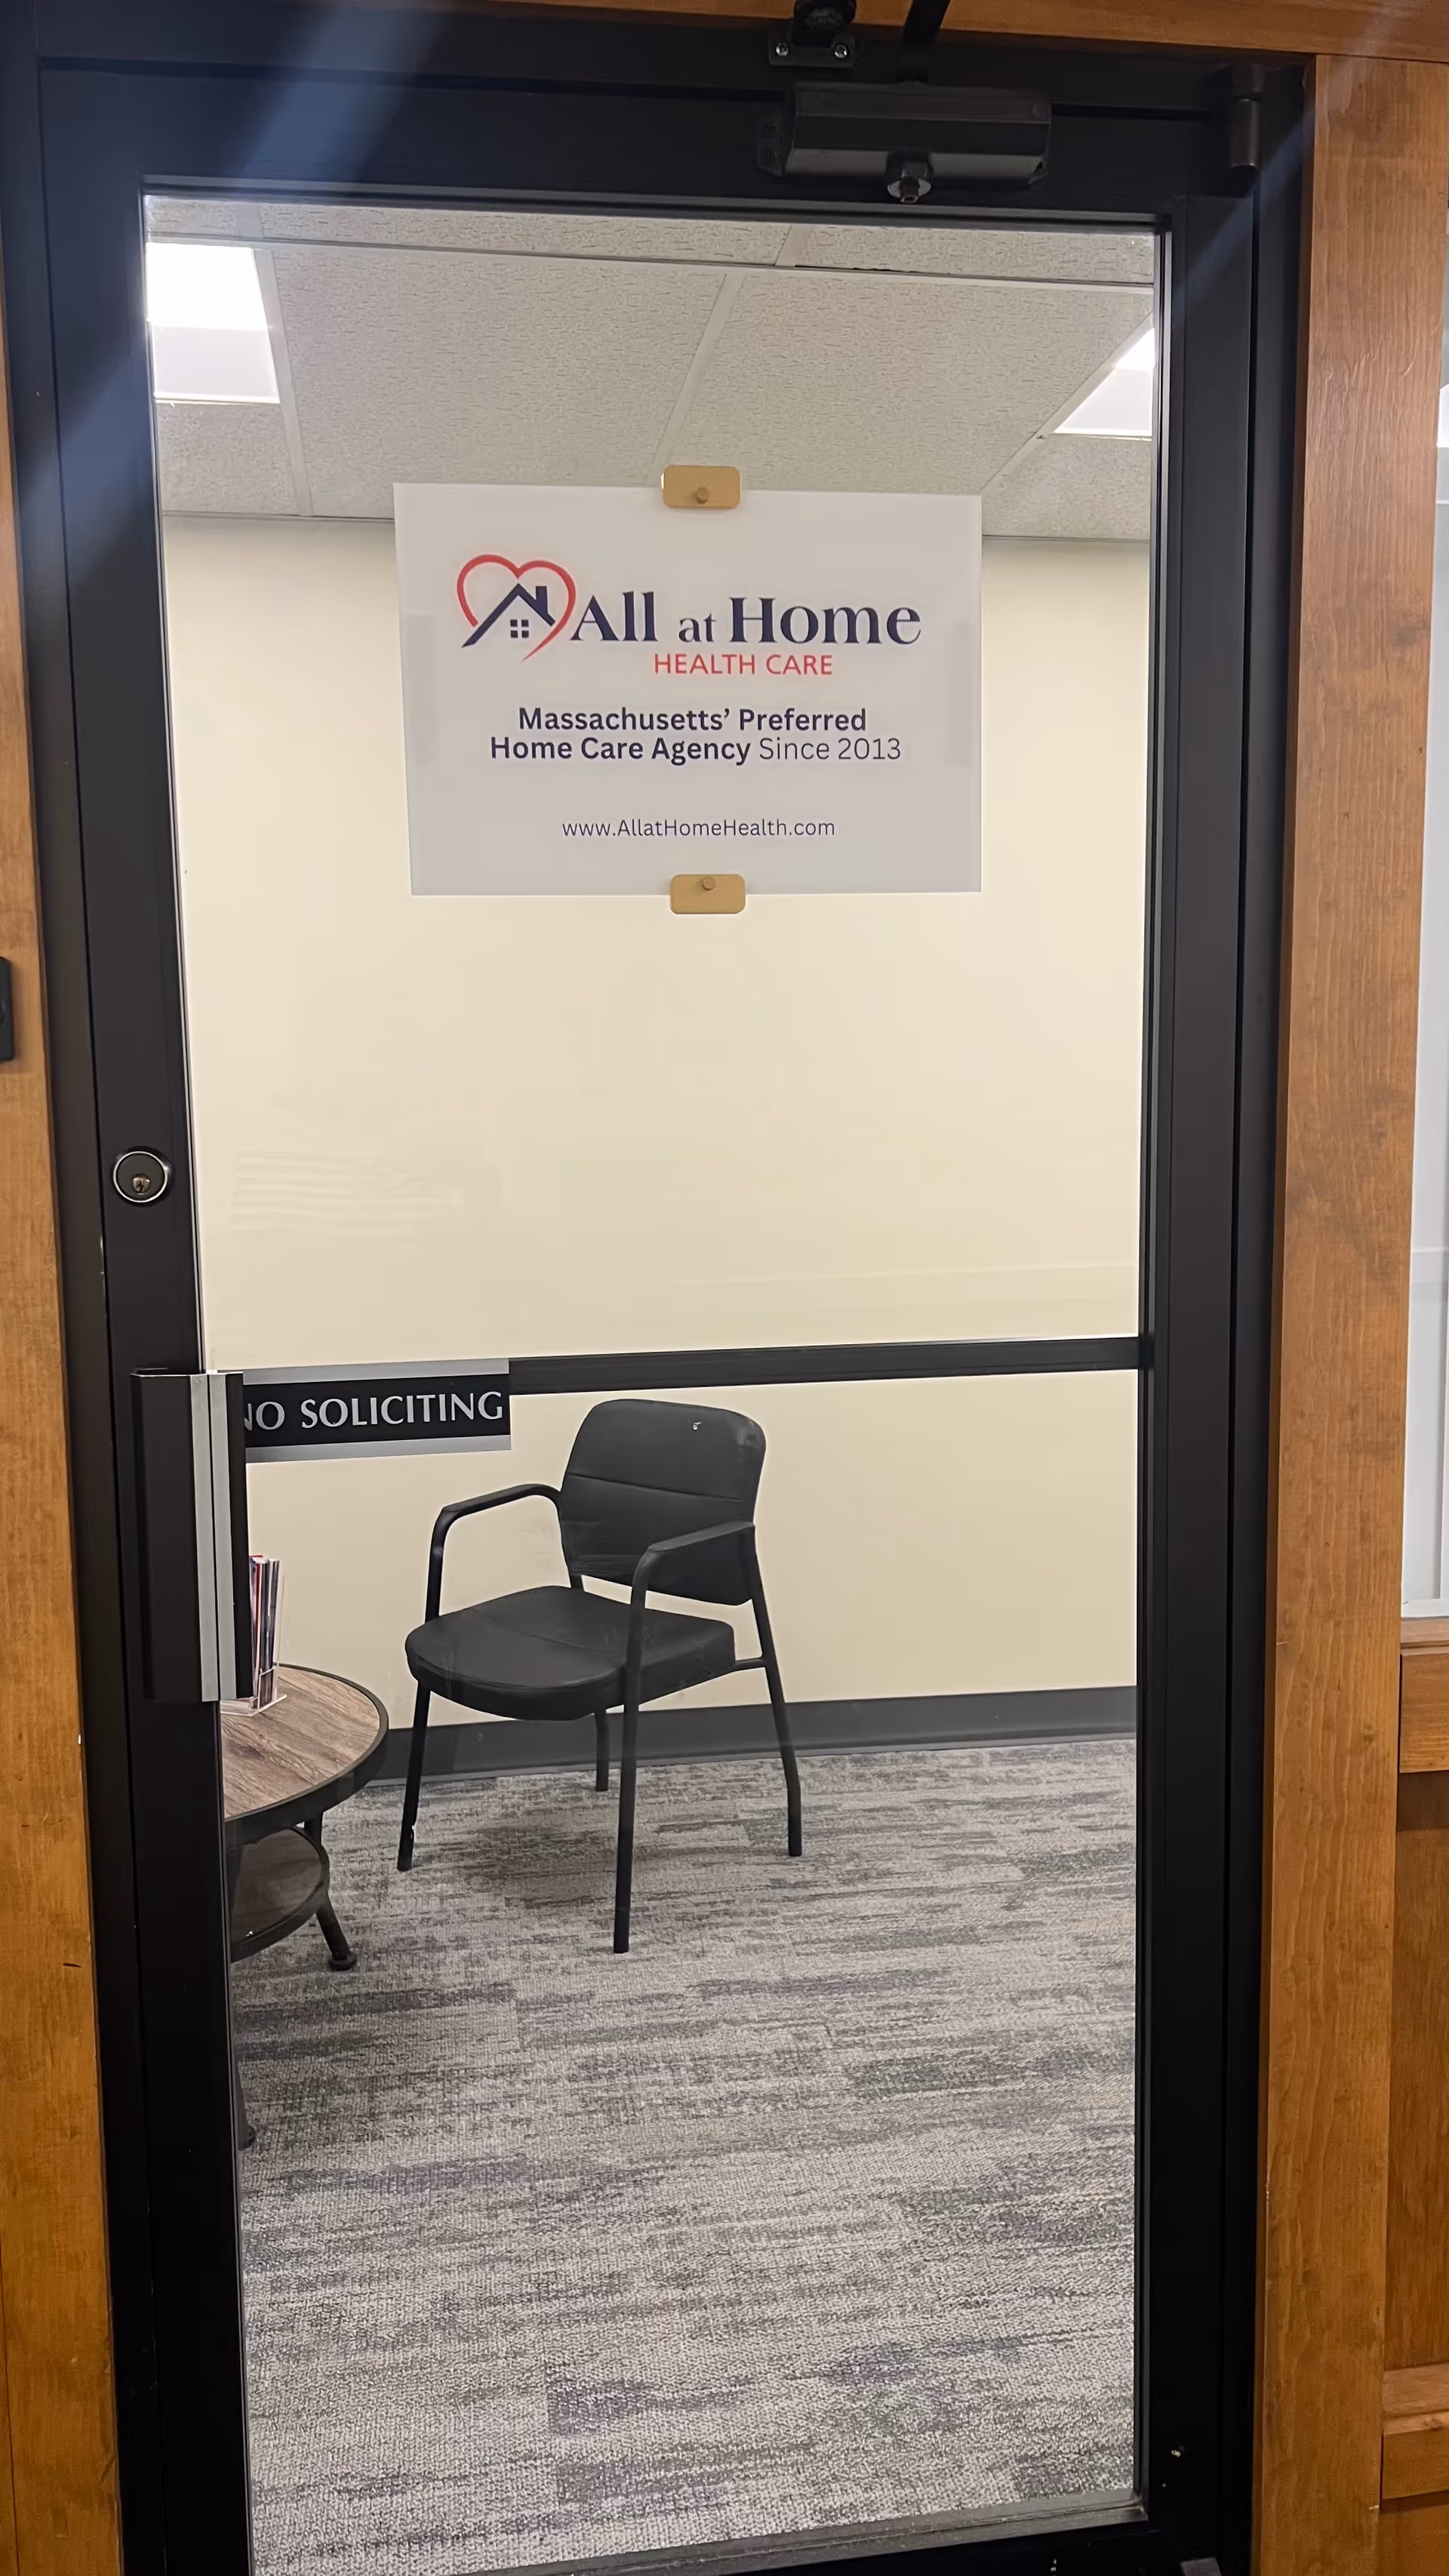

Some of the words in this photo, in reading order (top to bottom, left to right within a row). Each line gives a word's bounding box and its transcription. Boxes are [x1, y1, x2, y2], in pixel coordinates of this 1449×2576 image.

[571, 592, 657, 642] All
[678, 613, 716, 644] at
[729, 597, 921, 645] Home
[654, 653, 756, 676] HEALTH
[765, 654, 833, 676] CARE
[740, 707, 866, 731] Preferred
[491, 737, 572, 759] Home
[580, 737, 643, 759] Care
[651, 737, 751, 765] Agency
[759, 737, 829, 760] Since
[838, 737, 901, 761] 2013
[562, 818, 835, 838] www.AllatHomeHealth.com
[301, 1391, 503, 1429] SOLICITING
